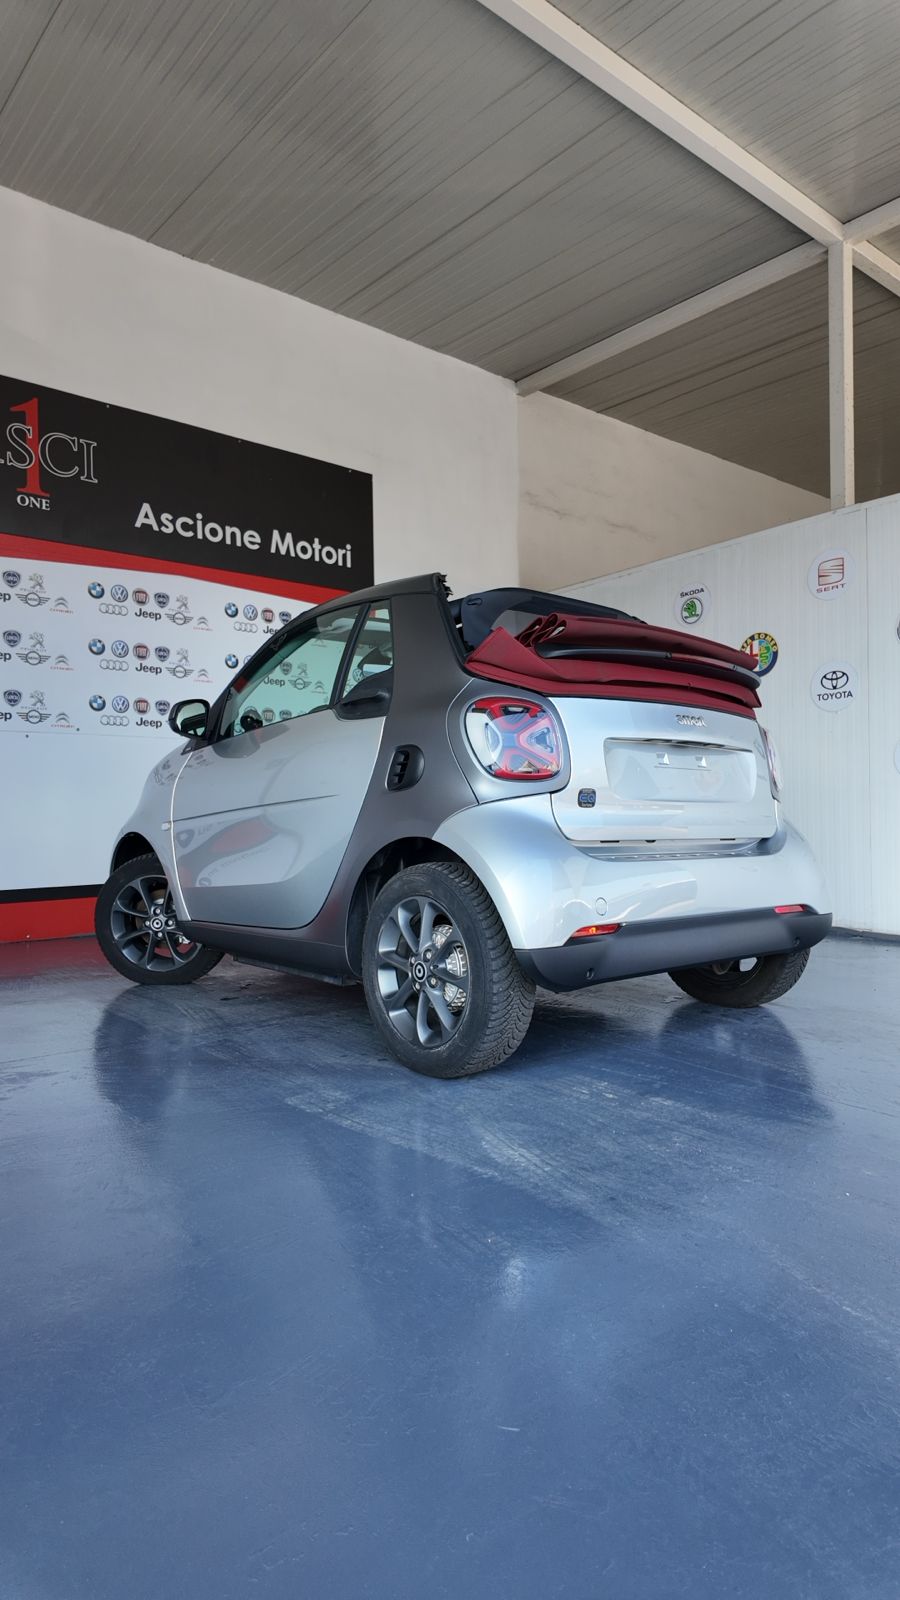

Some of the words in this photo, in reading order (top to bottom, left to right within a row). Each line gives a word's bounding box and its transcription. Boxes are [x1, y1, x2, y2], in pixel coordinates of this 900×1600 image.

[0, 423, 98, 484] SCI
[16, 494, 51, 511] ONE
[134, 502, 262, 550] Ascione
[270, 529, 352, 568] Motori
[680, 587, 705, 598] ŠKODA
[816, 583, 846, 594] SEAT
[134, 608, 162, 621] Jeep
[135, 662, 163, 676] Jeep
[263, 676, 286, 688] Jeep
[817, 690, 854, 701] TOYOTA
[135, 717, 163, 730] Jeep
